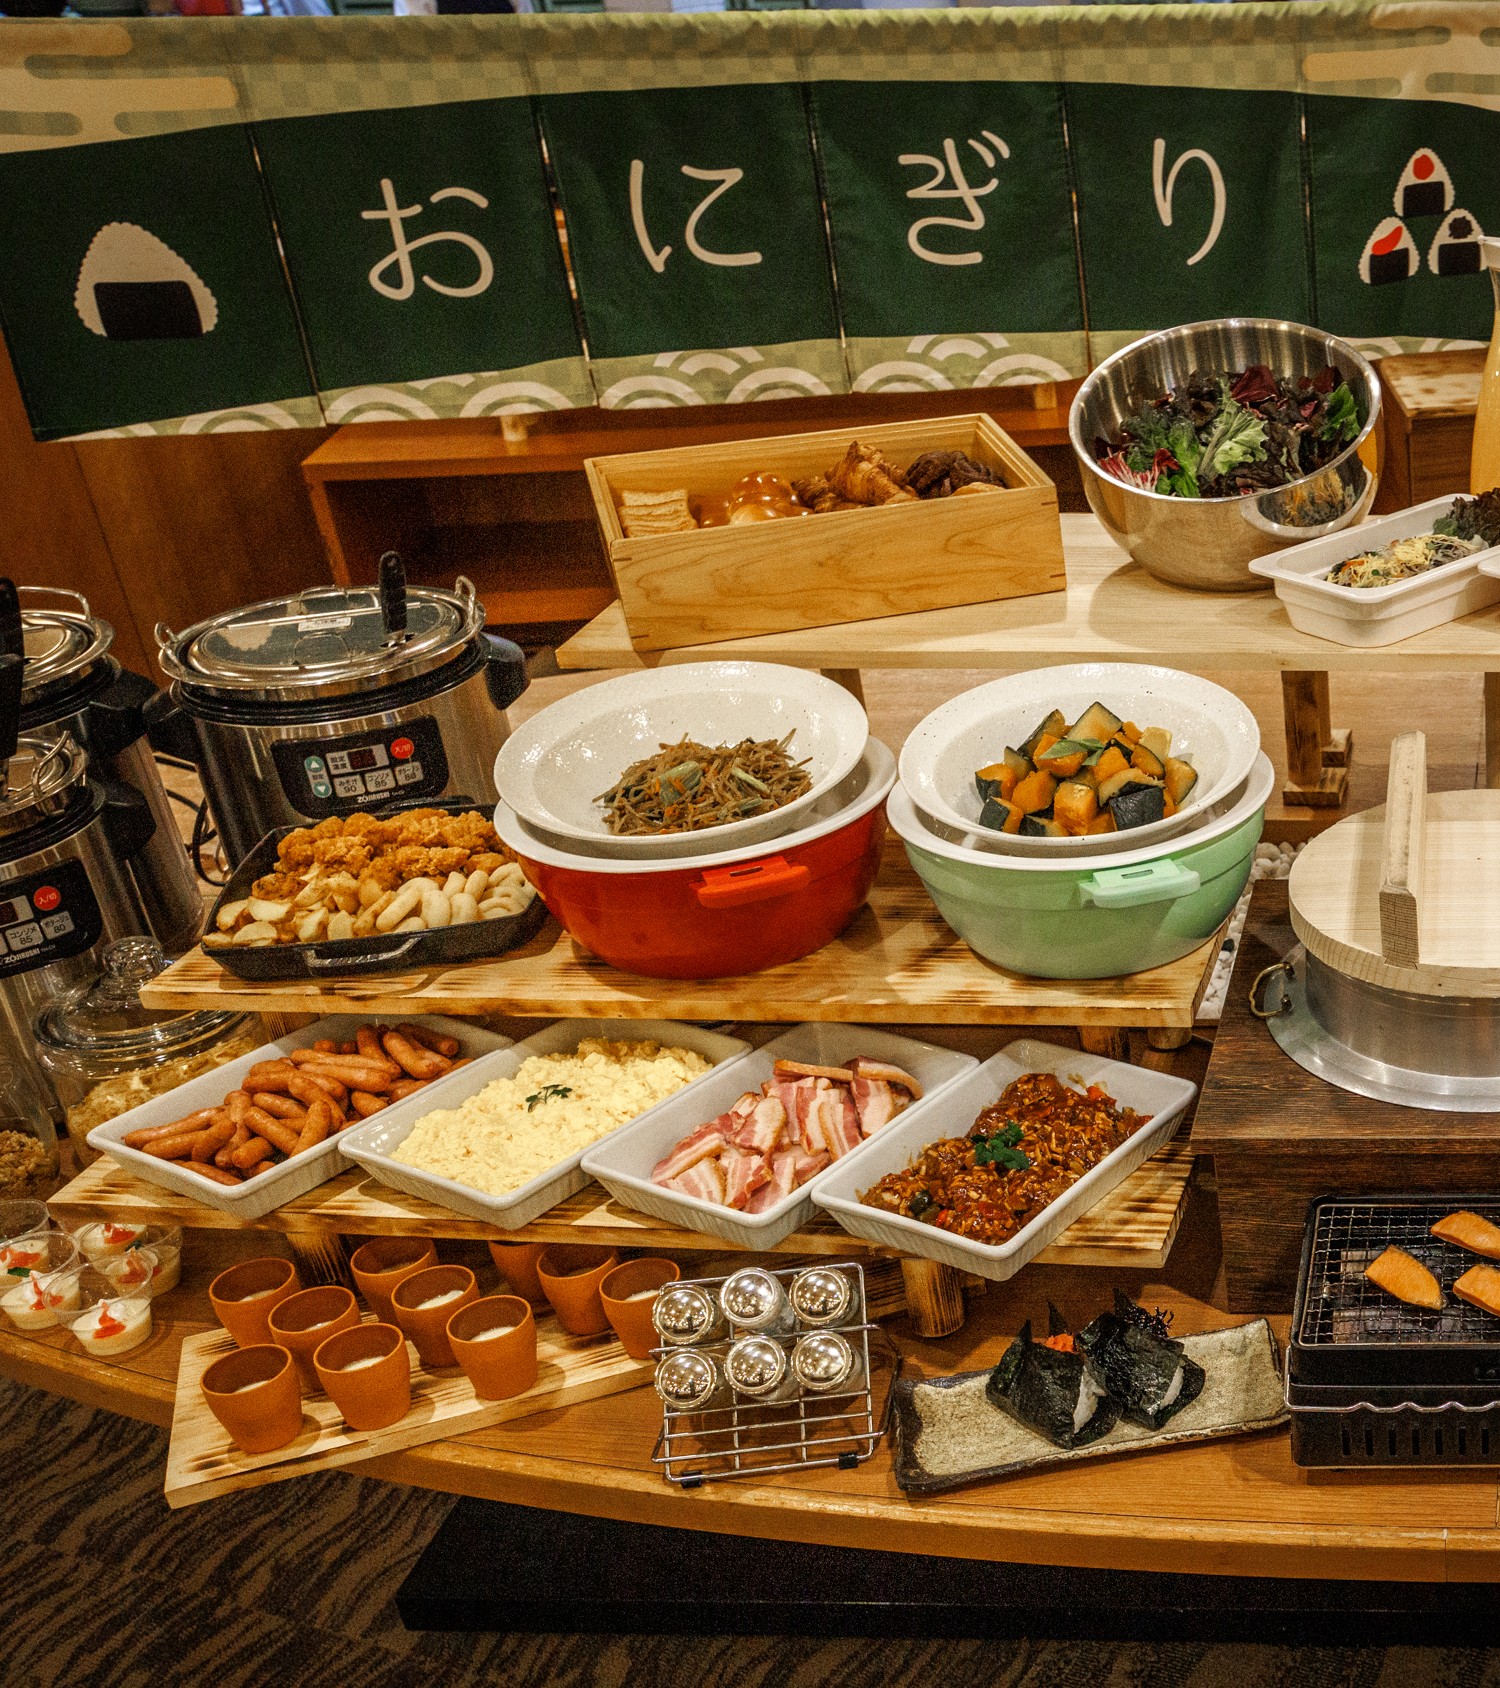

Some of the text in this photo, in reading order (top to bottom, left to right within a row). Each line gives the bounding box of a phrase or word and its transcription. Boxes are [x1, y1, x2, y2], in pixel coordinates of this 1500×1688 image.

[360, 130, 1227, 302] おにぎり
[343, 785, 357, 793] 90
[38, 892, 57, 905] 入/切
[9, 926, 37, 939] コンソメ
[53, 924, 66, 933] 80
[19, 936, 33, 945] 85
[3, 948, 40, 964] ZOJIRUSHI
